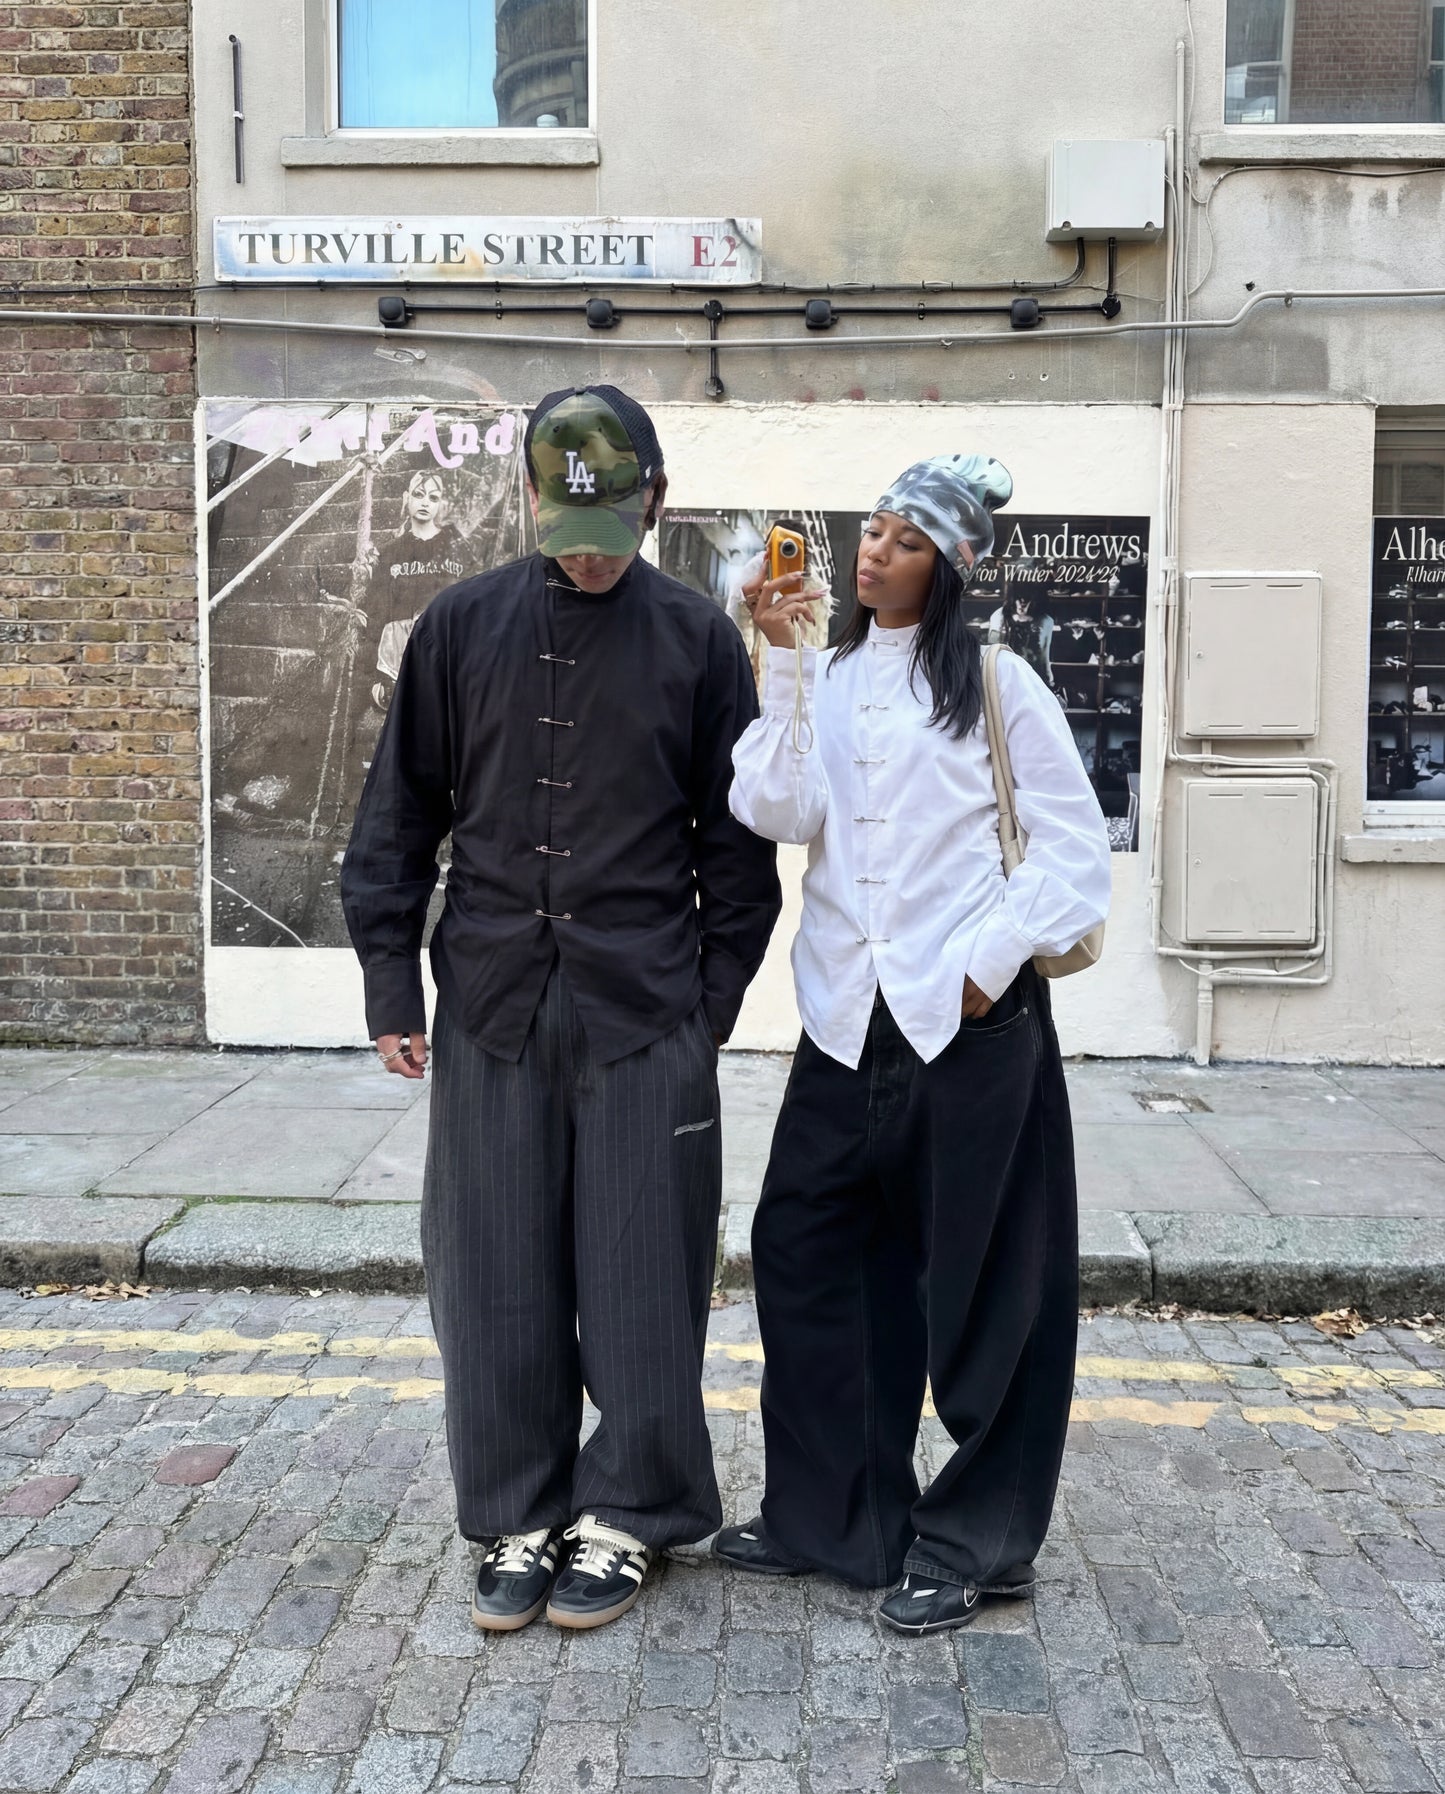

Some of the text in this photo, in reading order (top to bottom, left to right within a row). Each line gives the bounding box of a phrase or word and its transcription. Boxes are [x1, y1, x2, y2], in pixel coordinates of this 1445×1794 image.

[239, 233, 738, 267] TURVILLE STREET E2
[403, 407, 516, 469] And
[566, 452, 596, 493] LA
[1002, 522, 1141, 563] Andrews
